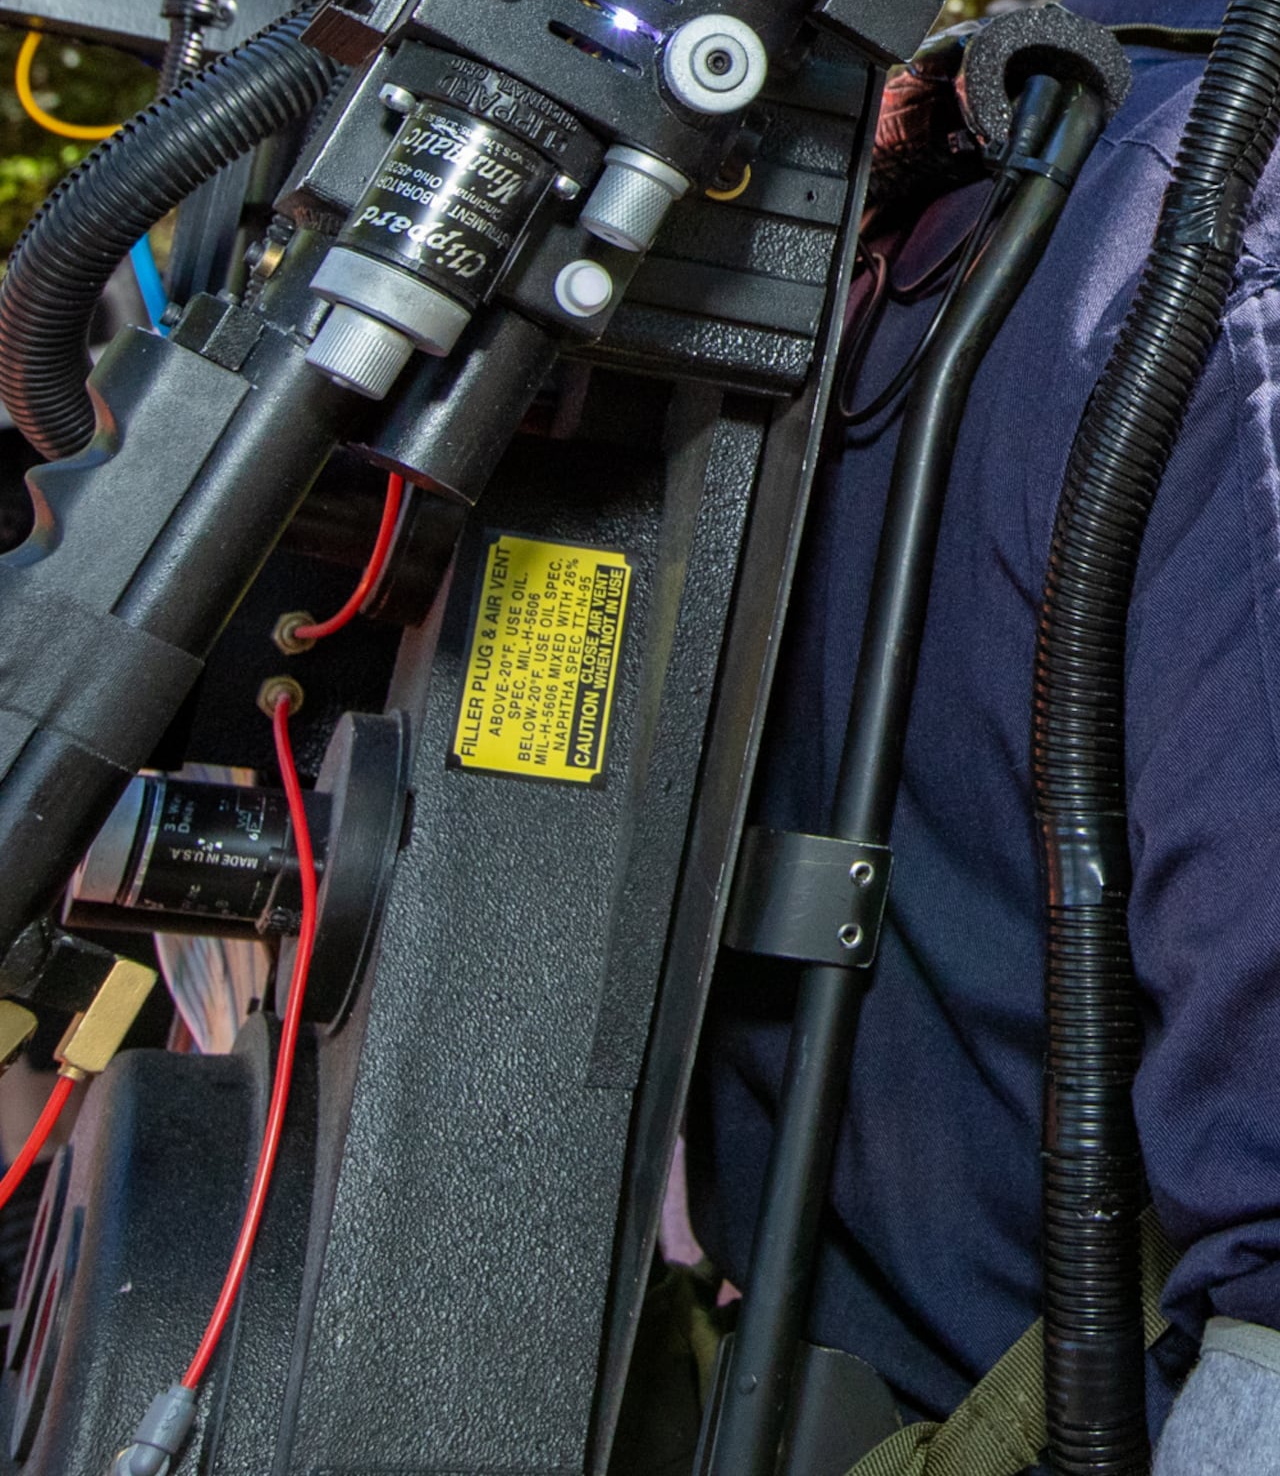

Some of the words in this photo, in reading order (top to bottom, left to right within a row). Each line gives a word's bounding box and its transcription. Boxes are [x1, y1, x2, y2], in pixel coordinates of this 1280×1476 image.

[411, 166, 443, 190] Ohio
[354, 205, 486, 279] Clippard
[490, 545, 510, 590] VENT
[545, 558, 563, 600] SPEC.
[563, 558, 579, 587] 26%
[609, 569, 624, 597] USE
[511, 572, 528, 601] OIL.
[572, 575, 592, 629] TT-N-95
[592, 570, 609, 607] VENT
[485, 595, 502, 624] AIR
[506, 606, 522, 636] USE
[539, 605, 555, 628] OIL
[556, 591, 573, 628] WITH
[588, 609, 603, 634] AIR
[605, 598, 619, 613] IN
[481, 628, 496, 640] &
[516, 593, 541, 671] MIL-H-5606
[534, 632, 551, 662] USE
[600, 615, 616, 645] NOT
[472, 644, 493, 692] PLUG
[548, 632, 566, 679] MIXED
[565, 634, 582, 674] SPEC
[580, 635, 600, 684] CLOSE
[593, 645, 612, 689] WHEN
[507, 676, 527, 720] SPEC.
[553, 679, 575, 752] NAPHTHA
[461, 696, 484, 757] FILLER
[534, 684, 558, 765] MIL-H-5606
[574, 690, 600, 766] CAUTION
[168, 846, 204, 862] U.S.A.
[205, 852, 219, 864] IN
[220, 853, 258, 869] MADE
